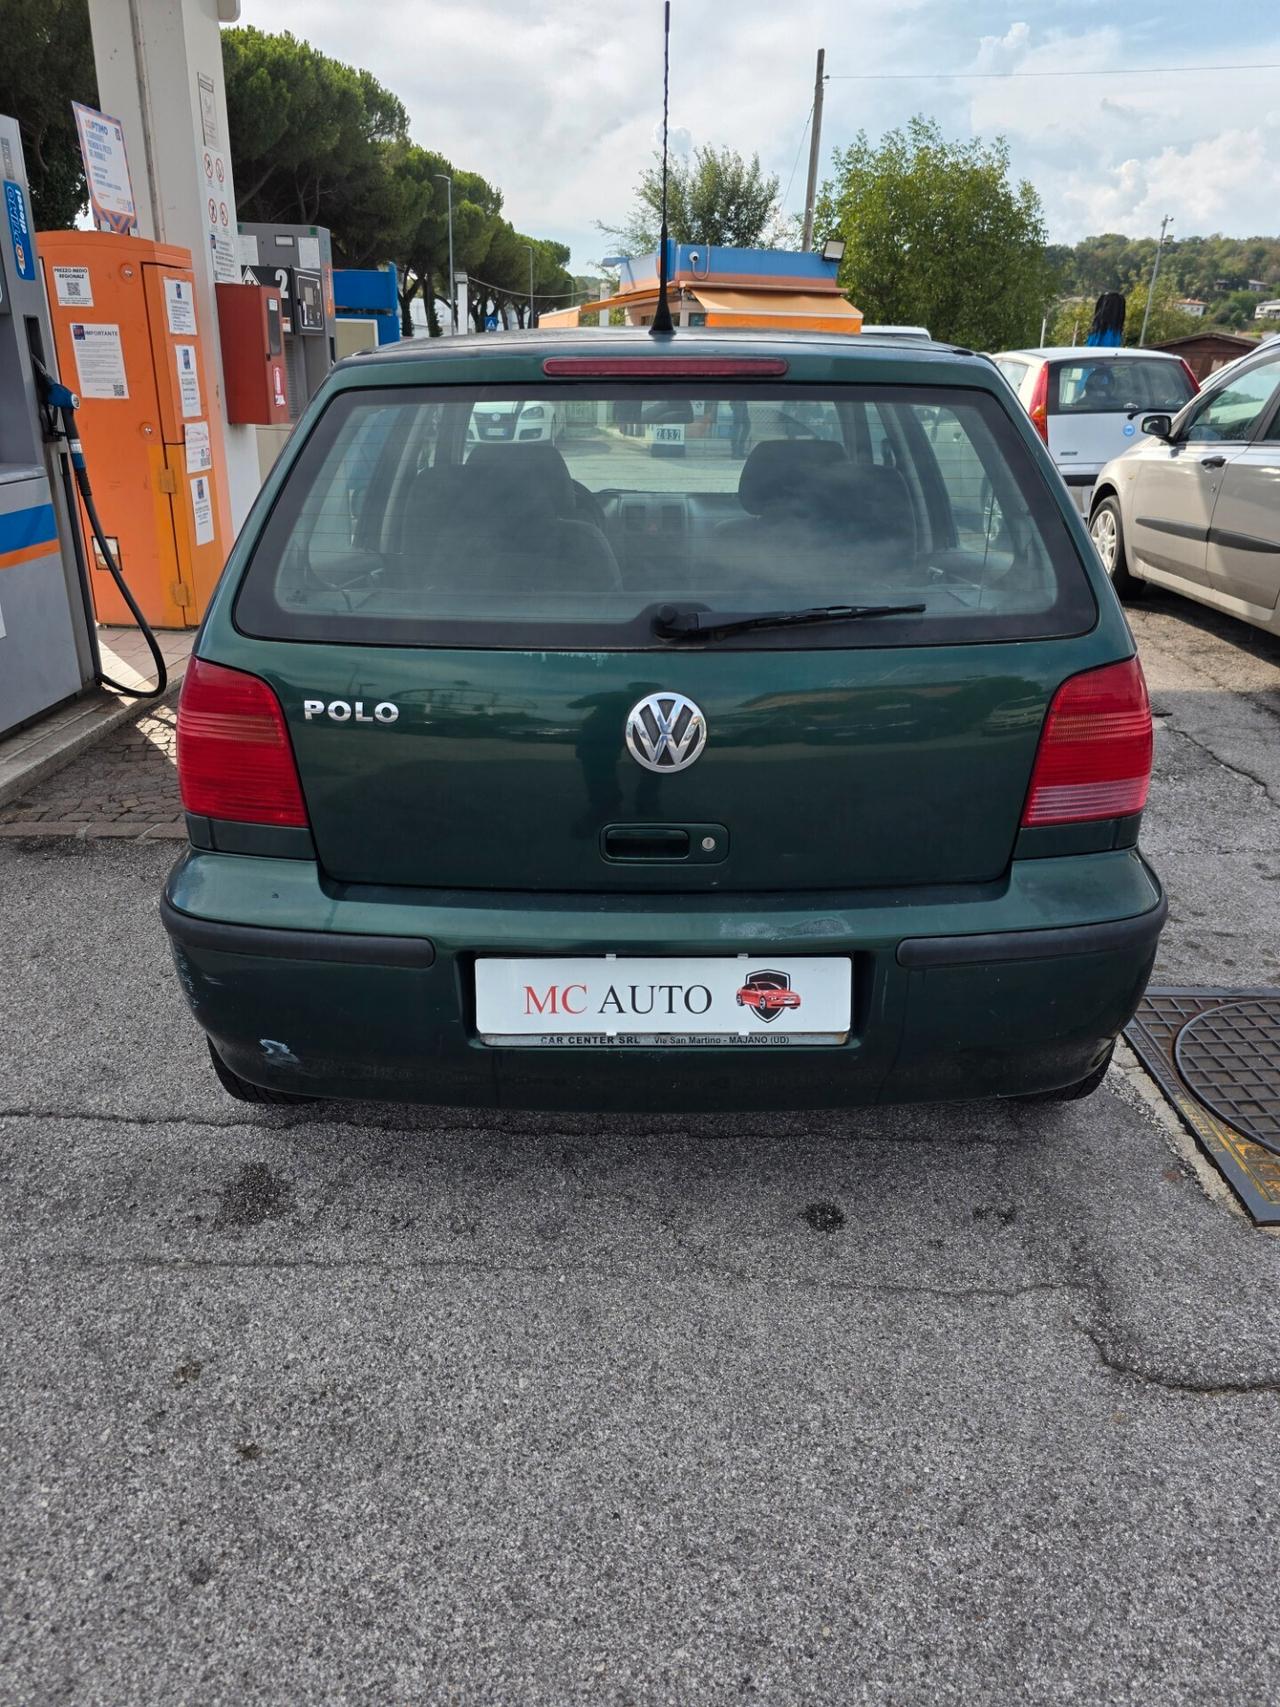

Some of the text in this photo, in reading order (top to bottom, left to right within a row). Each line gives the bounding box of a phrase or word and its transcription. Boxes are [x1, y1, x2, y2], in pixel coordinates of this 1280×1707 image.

[15, 189, 27, 234] diesel
[275, 268, 289, 299] 2
[304, 700, 399, 723] POLO
[523, 984, 713, 1015] MC AUTO
[541, 1036, 564, 1044] CAR
[567, 1036, 615, 1044] CENTER
[618, 1036, 641, 1044] SRL
[654, 1036, 667, 1044] Via
[670, 1036, 686, 1044] San
[688, 1036, 721, 1044] Martino
[729, 1036, 768, 1045] MAJANO
[770, 1036, 790, 1045] (UD)
